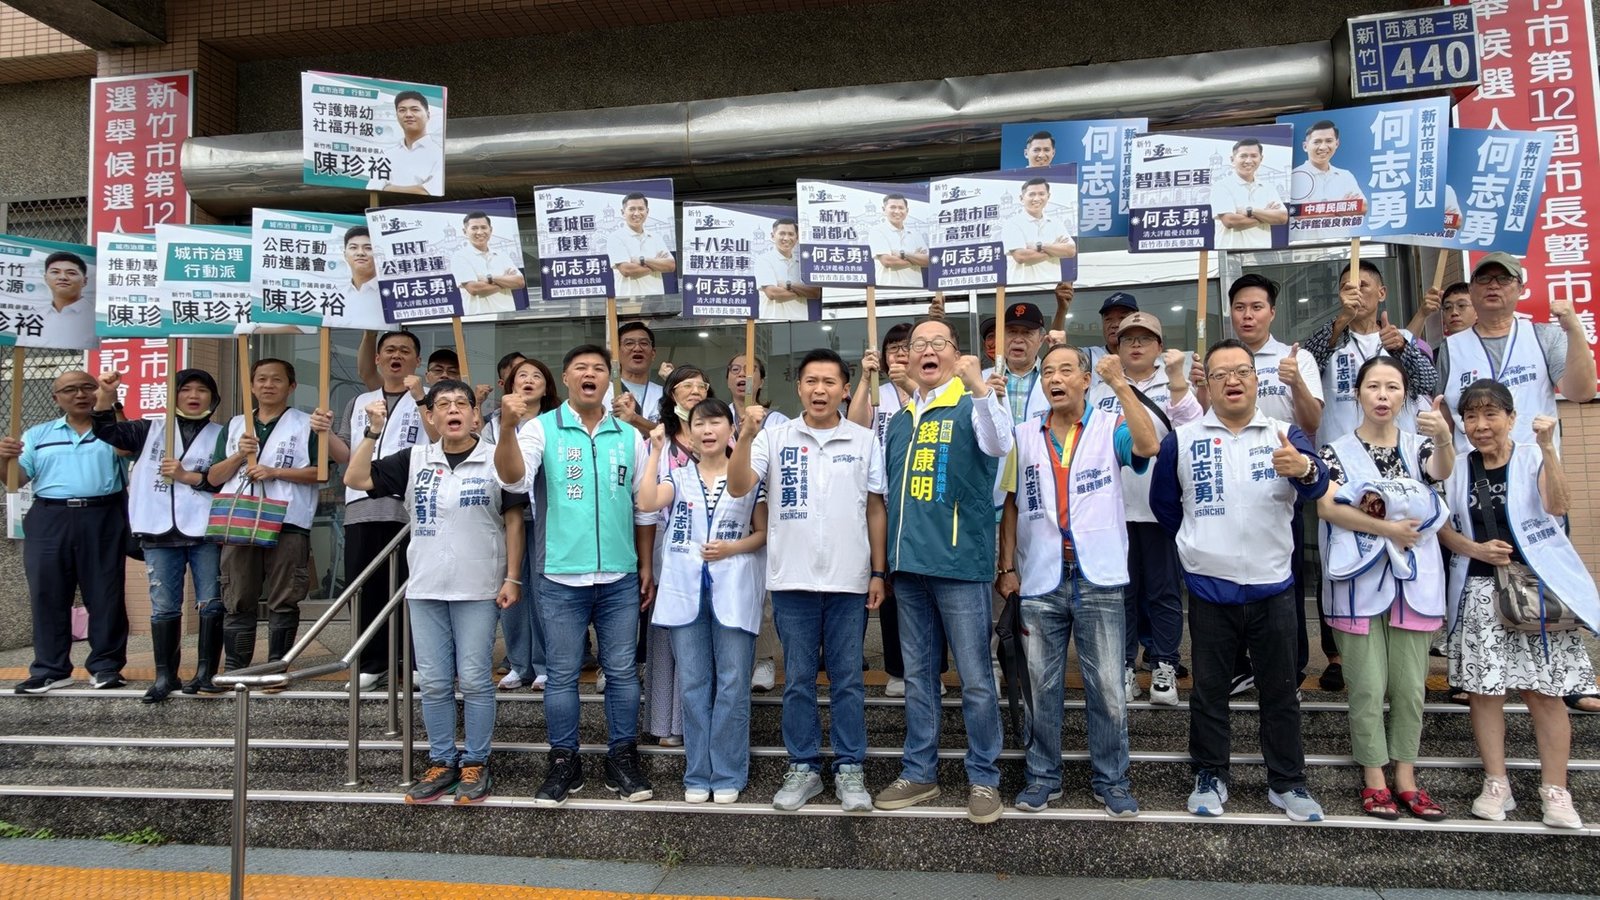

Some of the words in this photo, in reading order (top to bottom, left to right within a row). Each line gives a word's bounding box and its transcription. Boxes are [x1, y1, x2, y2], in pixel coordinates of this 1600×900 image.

[1384, 13, 1469, 40] 西濱路一段
[1356, 27, 1379, 88] 新竹市
[1390, 40, 1470, 84] 440
[313, 101, 374, 120] 守護婦幼
[313, 118, 374, 137] 社福升級
[314, 151, 392, 181] 陳珍裕
[1418, 109, 1437, 205] 新竹市長候選人
[1080, 125, 1118, 232] 何志勇
[1135, 168, 1211, 189] 智慧巨蛋
[1367, 109, 1413, 230] 何志勇
[1459, 135, 1520, 246] 何志勇
[1508, 141, 1541, 229] 新竹市長候選人
[819, 209, 849, 223] 新竹
[938, 204, 998, 224] 台鐵市區
[1304, 201, 1358, 213] 中華民國派
[547, 215, 595, 232] 舊城區
[1142, 208, 1200, 229] 何志勇
[812, 225, 857, 240] 副都心
[945, 223, 990, 240] 高架化
[174, 245, 244, 261] 城市治理
[262, 237, 327, 255] 公民行動
[392, 240, 427, 256] BRT
[557, 235, 588, 251] 復甦
[690, 237, 749, 252] 十八尖山
[262, 254, 326, 272] 前進議會
[690, 255, 750, 270] 觀光纜車
[811, 246, 861, 264] 何志勇
[941, 245, 993, 267] 何志勇
[184, 264, 236, 279] 行動派
[382, 256, 444, 275] 公車捷運
[551, 258, 600, 277] 何志勇
[392, 278, 447, 300] 何志勇
[695, 277, 747, 296] 何志勇
[262, 288, 346, 317] 陳珍裕
[1337, 354, 1350, 393] 何志勇
[911, 420, 940, 501] 錢康明
[566, 447, 584, 500] 陳珍裕
[779, 446, 799, 508] 何志勇
[1190, 438, 1213, 504] 何志勇
[1213, 447, 1224, 502] 新竹市長候選人
[1025, 465, 1038, 511] 何志勇
[1076, 475, 1113, 495] 服務團隊
[414, 468, 435, 524] 何志勇
[672, 501, 687, 544] 何志勇
[780, 512, 808, 520] HSINCHU
[1194, 507, 1225, 518] HSINCHU
